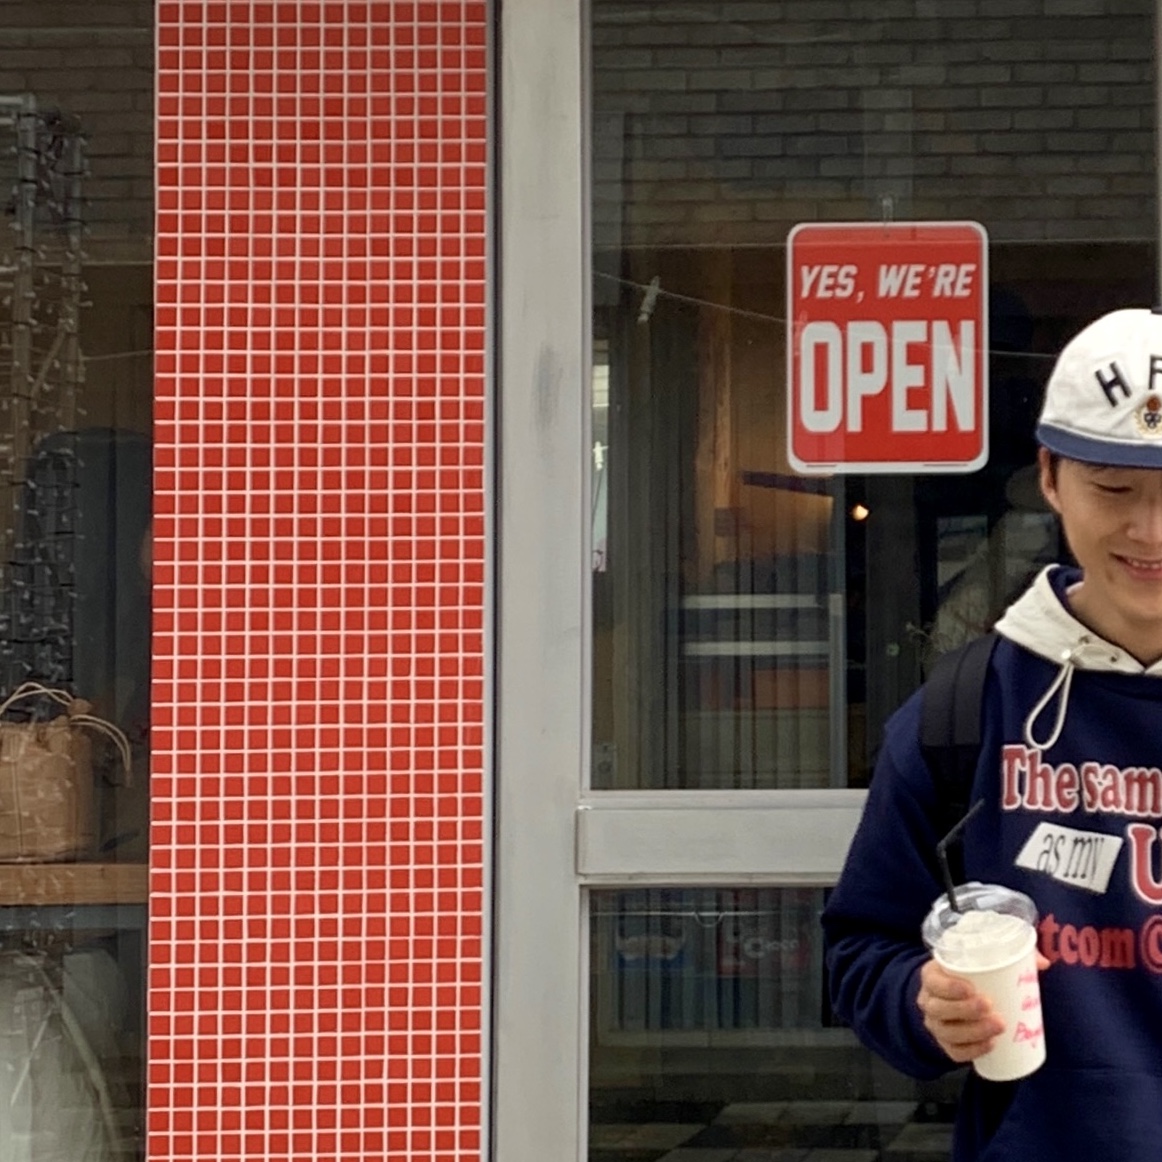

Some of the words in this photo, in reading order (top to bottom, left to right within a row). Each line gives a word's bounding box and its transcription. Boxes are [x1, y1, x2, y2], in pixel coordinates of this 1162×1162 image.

[800, 264, 865, 303] YES,
[877, 264, 977, 298] WE'RE
[800, 320, 976, 432] OPEN
[1002, 744, 1080, 812] The
[1037, 833, 1066, 875] as
[1062, 835, 1106, 888] my
